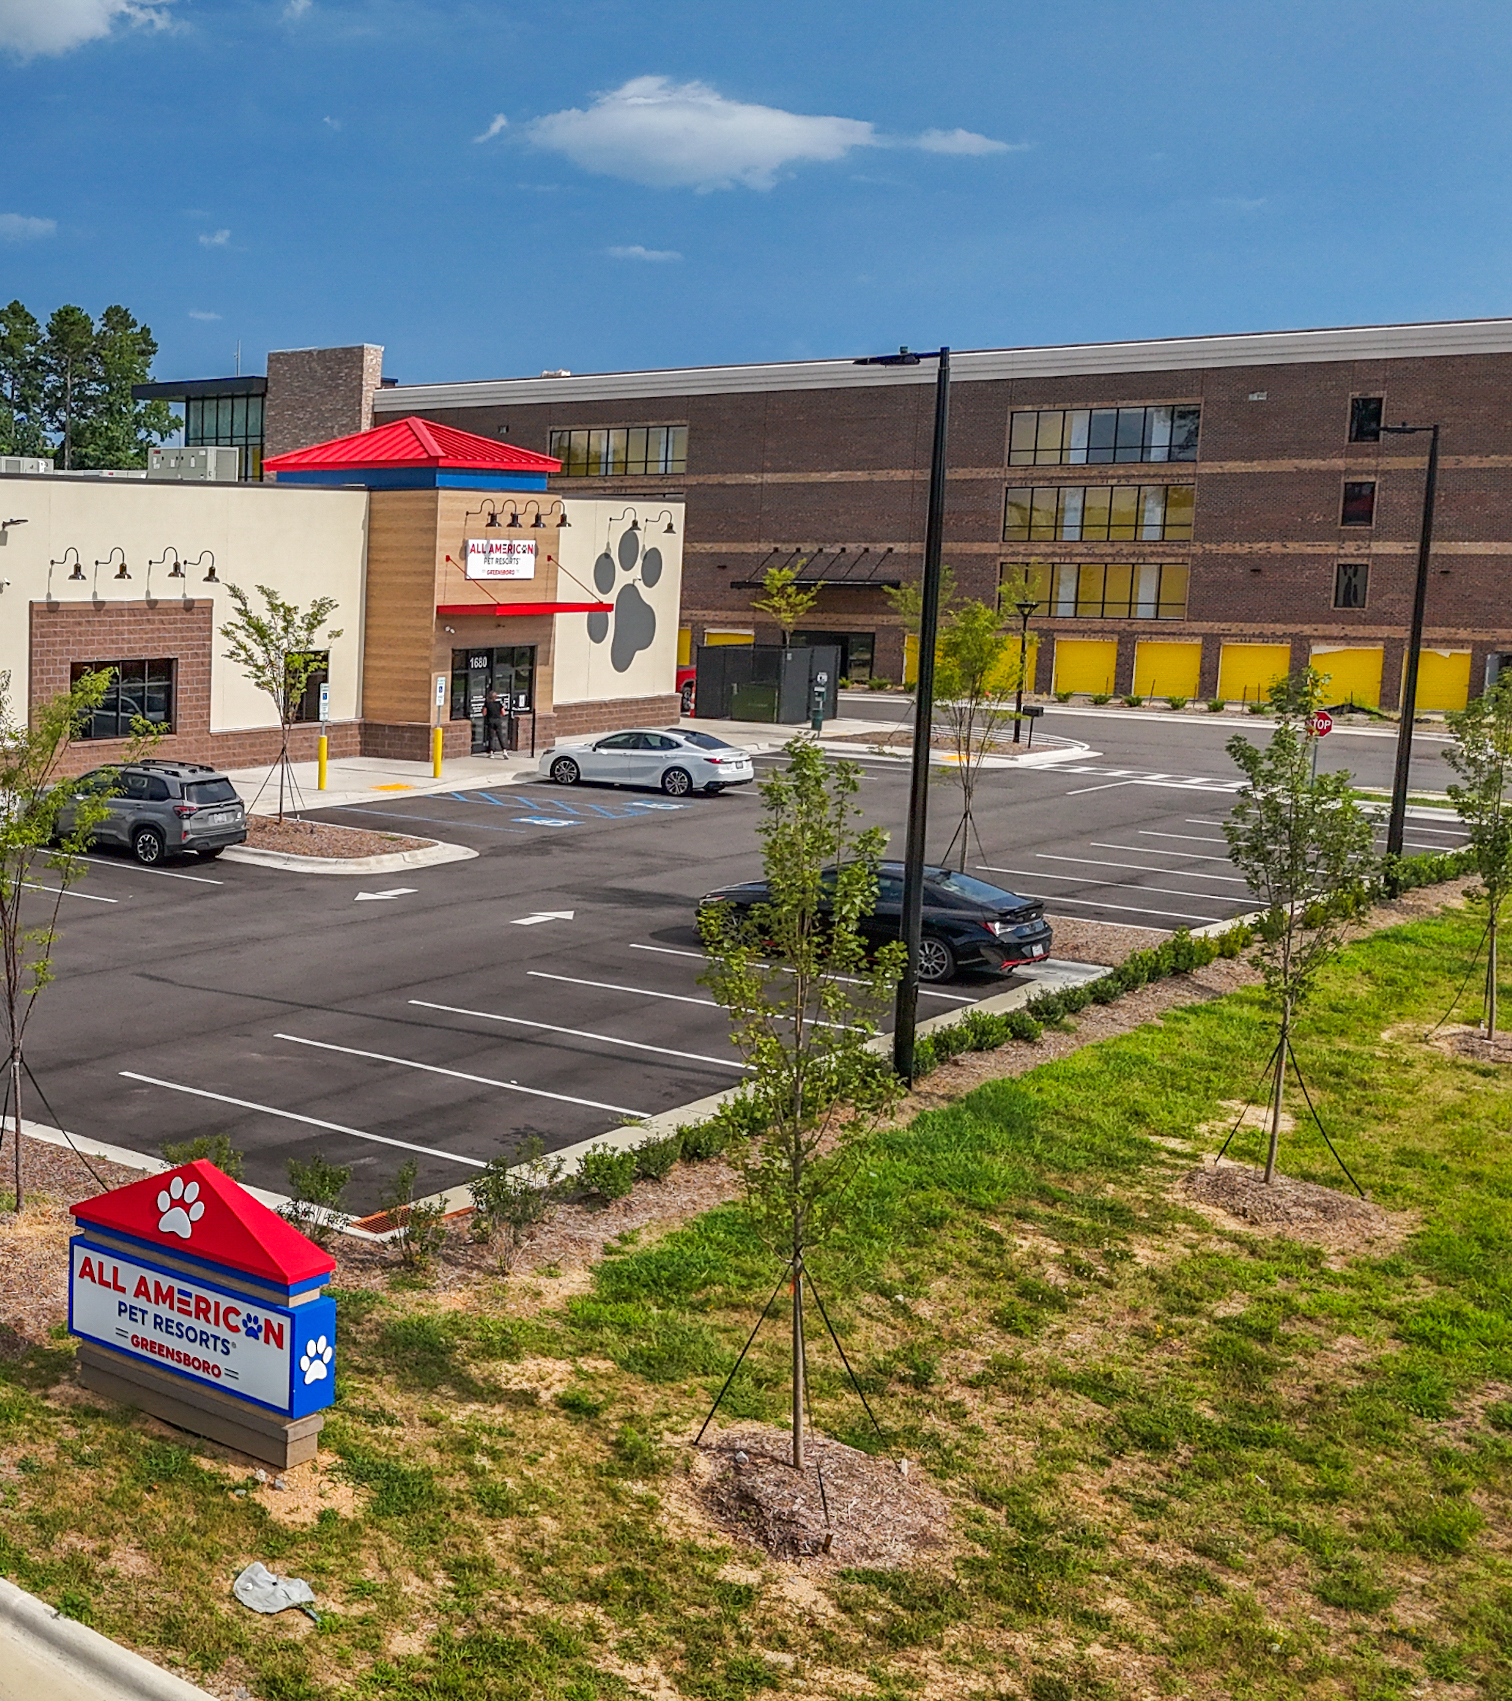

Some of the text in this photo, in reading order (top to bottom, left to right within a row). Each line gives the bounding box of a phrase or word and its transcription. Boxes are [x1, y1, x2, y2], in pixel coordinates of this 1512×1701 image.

[470, 543, 534, 554] ALL AMERICN
[484, 557, 494, 565] PET
[78, 1256, 284, 1350] ALL AMERICN
[117, 1301, 148, 1326] PET
[131, 1334, 222, 1379] GREENSBORO
